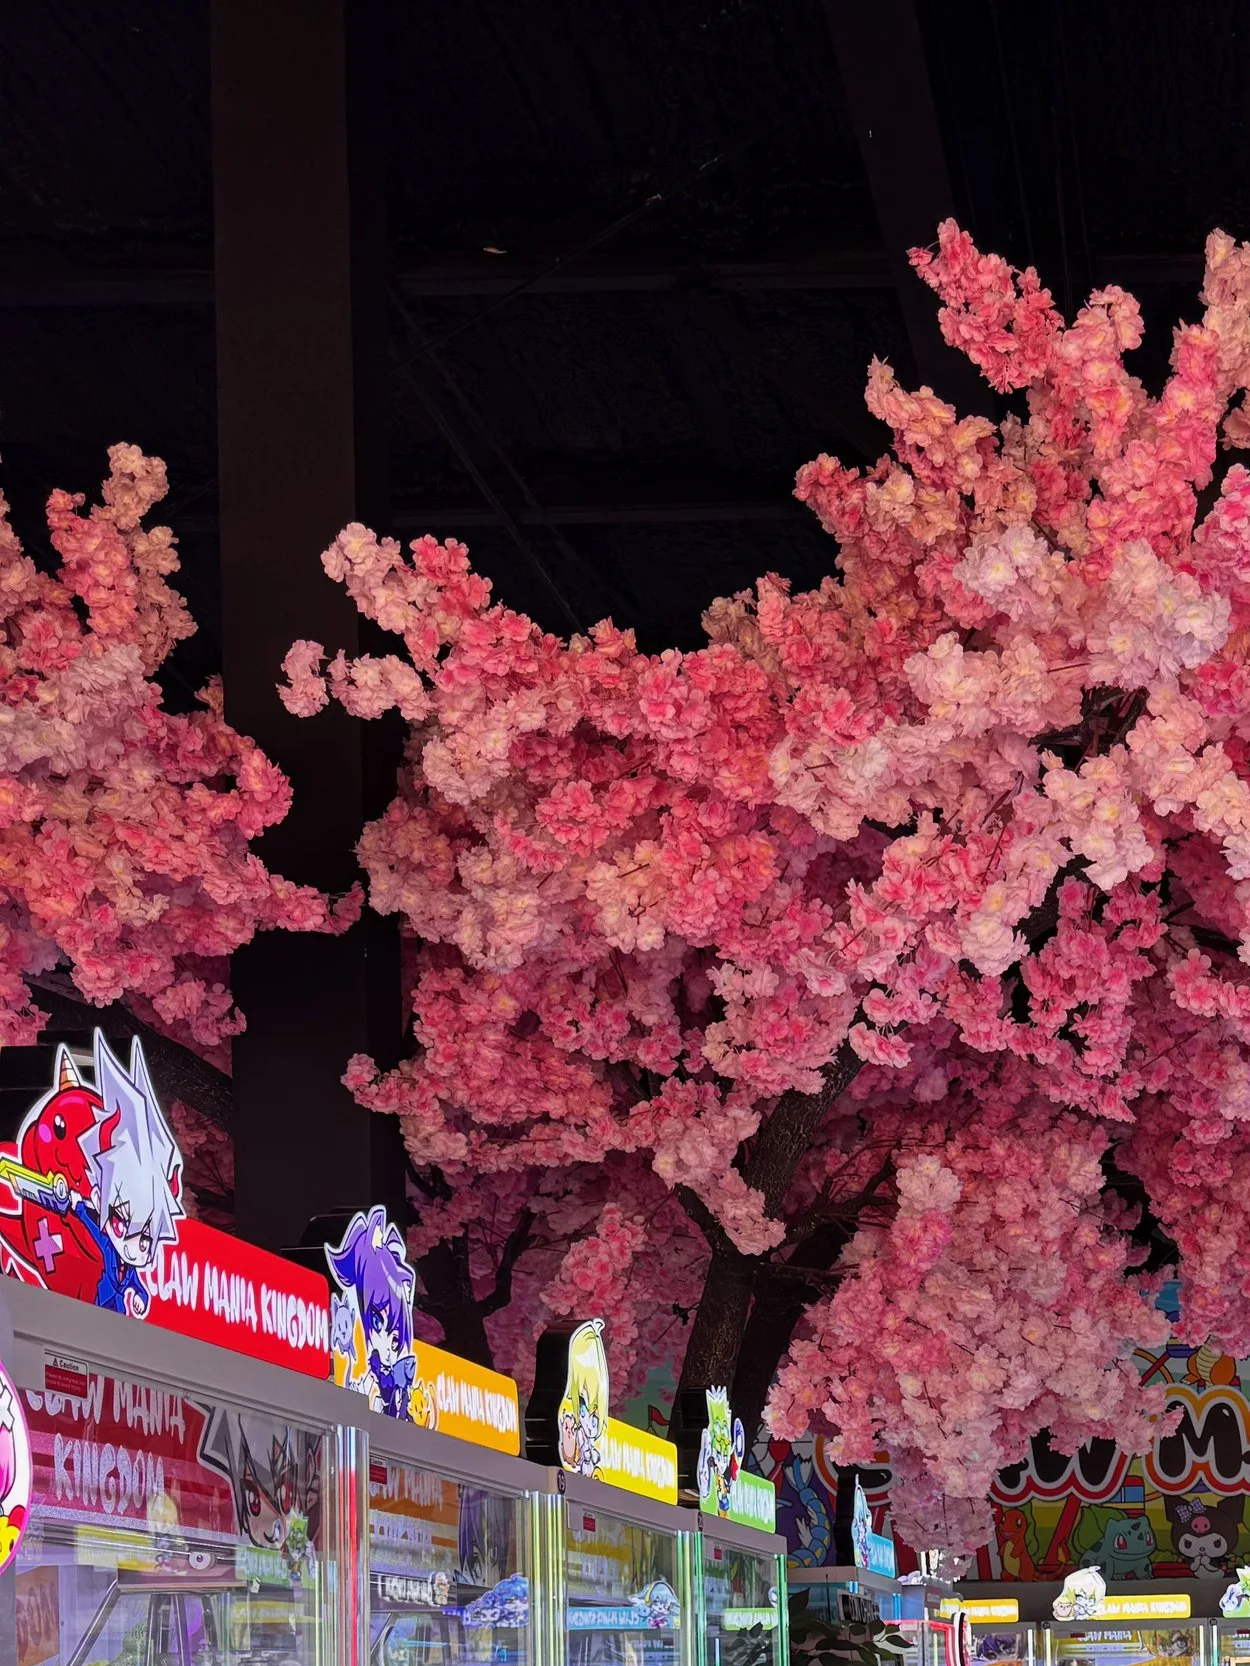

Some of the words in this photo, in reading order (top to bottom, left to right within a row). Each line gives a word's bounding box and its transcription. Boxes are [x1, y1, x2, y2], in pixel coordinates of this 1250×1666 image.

[203, 1260, 258, 1333] MANIA
[260, 1282, 329, 1354] KINGDOM
[460, 1379, 485, 1427] MANIA
[54, 1433, 165, 1515] KINGDOM
